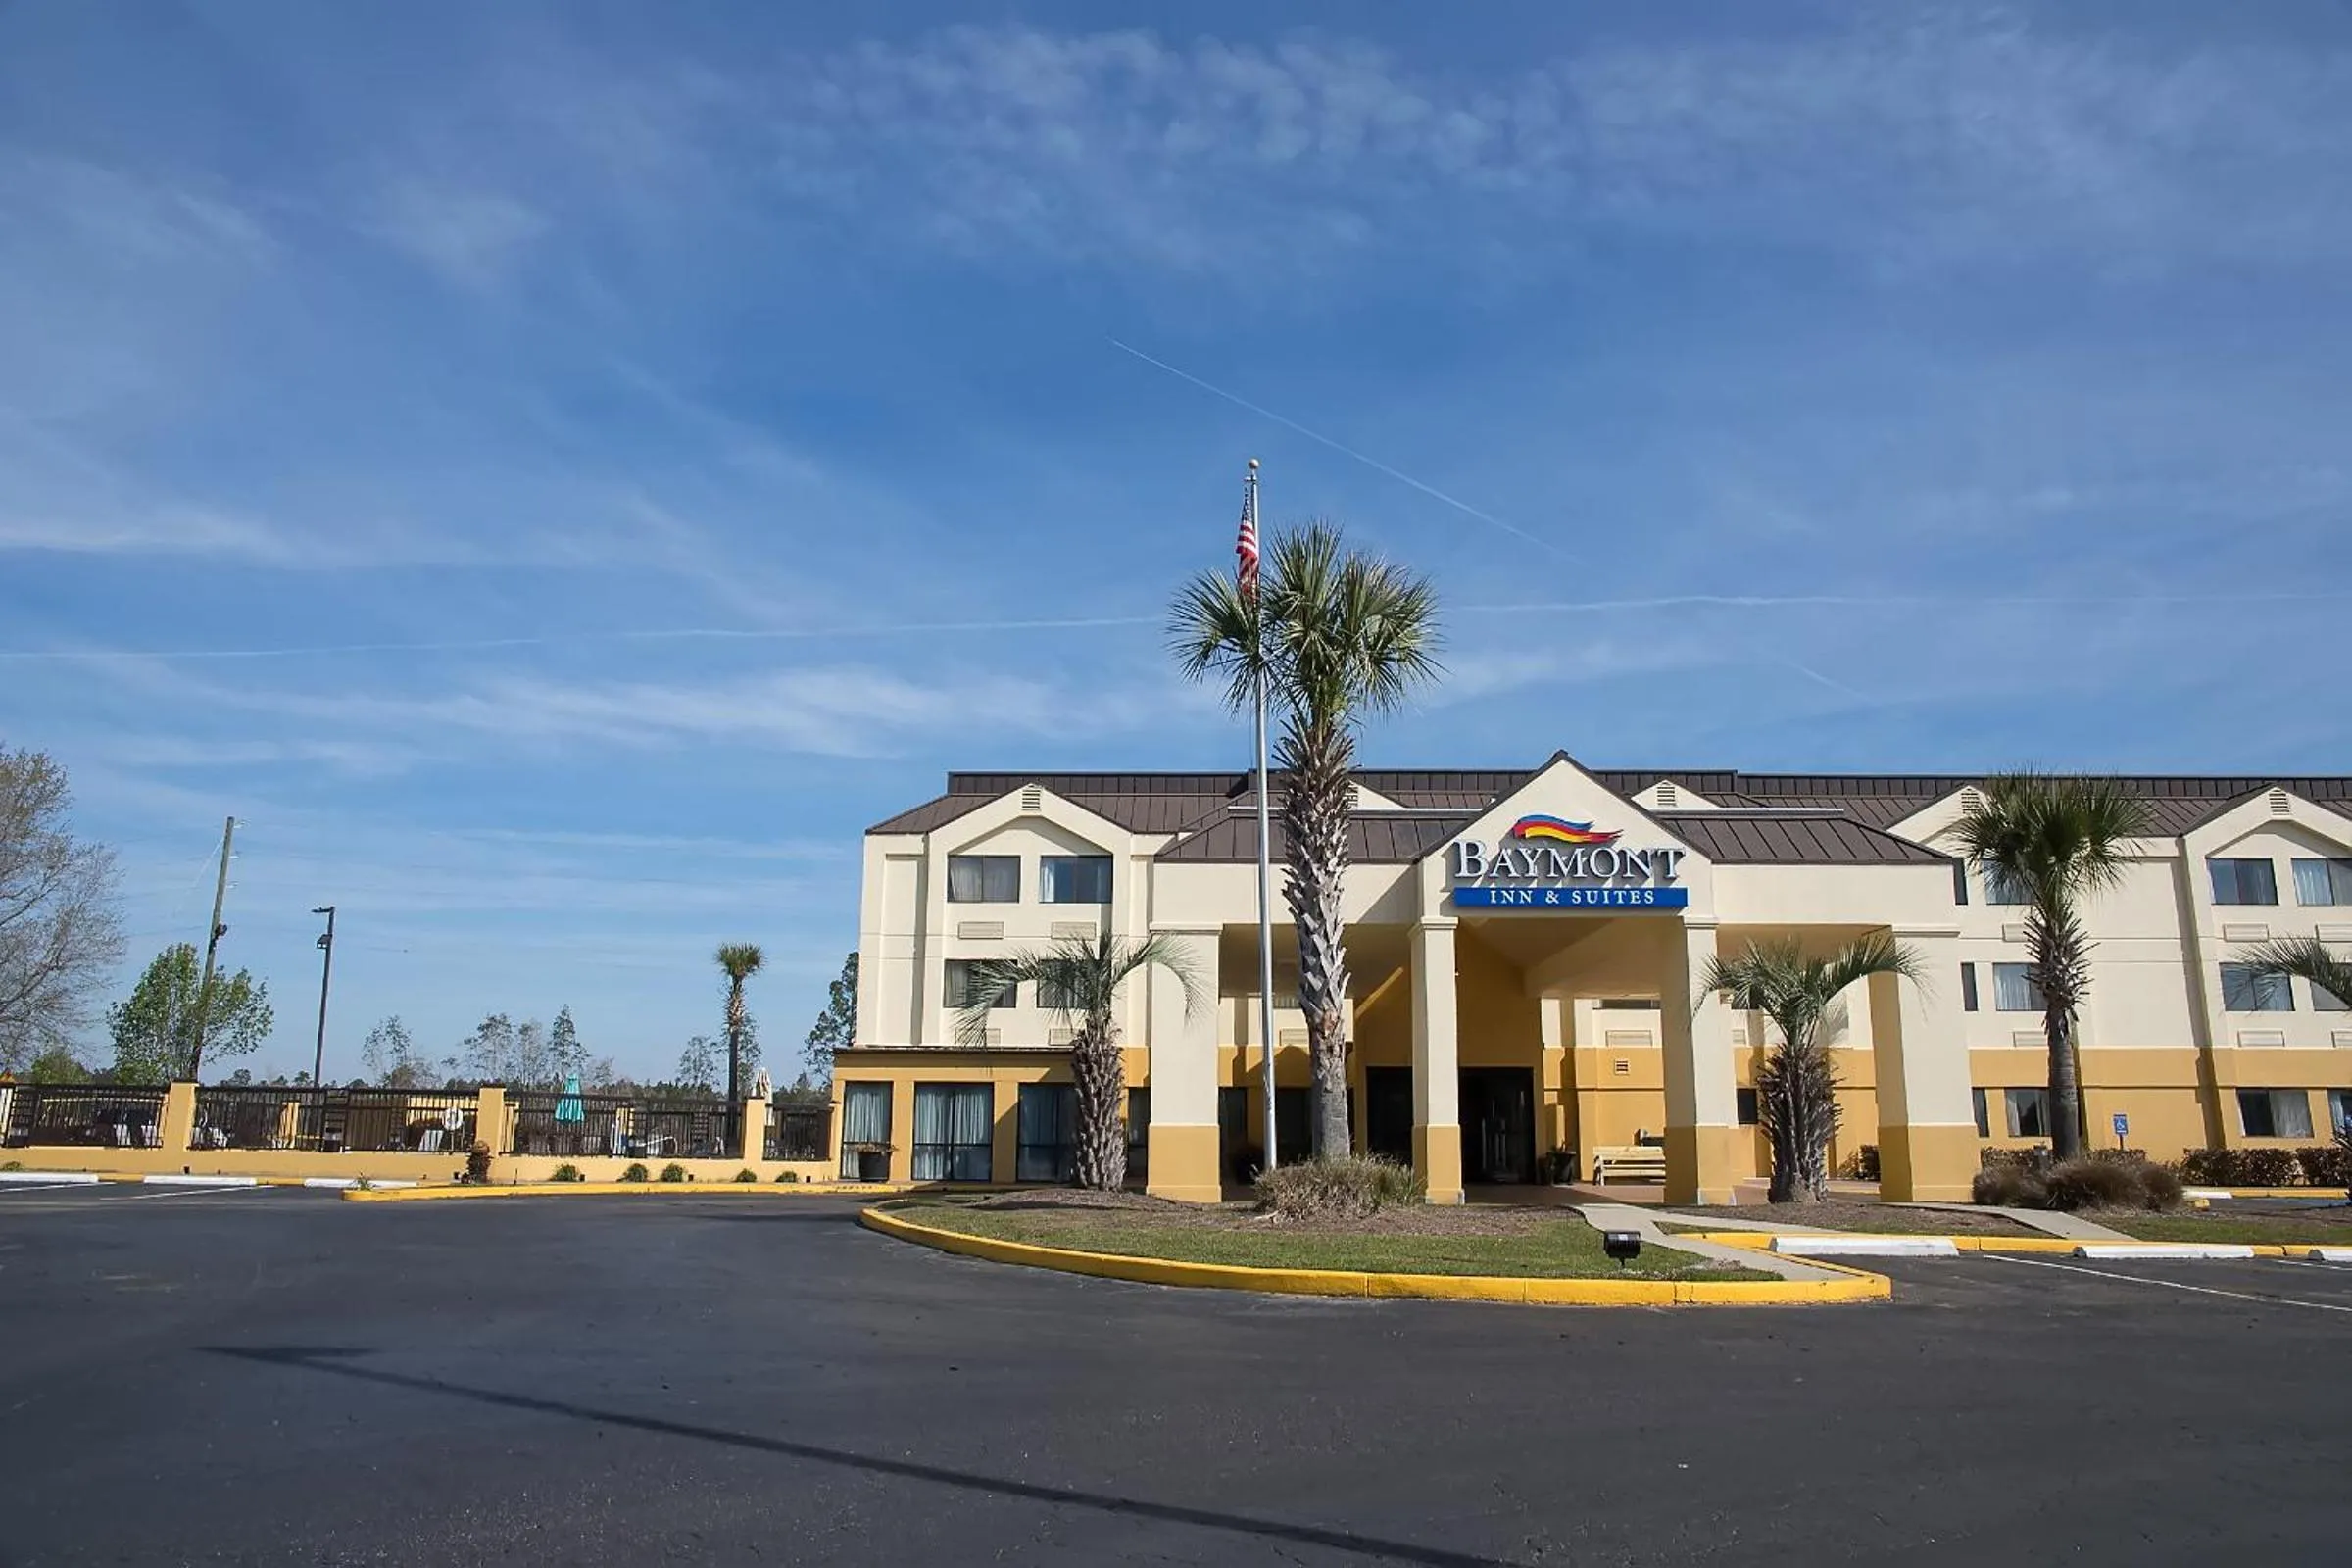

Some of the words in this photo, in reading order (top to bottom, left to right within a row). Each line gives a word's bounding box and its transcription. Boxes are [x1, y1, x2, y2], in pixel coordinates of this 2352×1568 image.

[1454, 841, 1686, 878] BAYMONT
[1490, 889, 1533, 904] INN
[1545, 889, 1560, 905] &
[1571, 889, 1655, 905] SUITES
